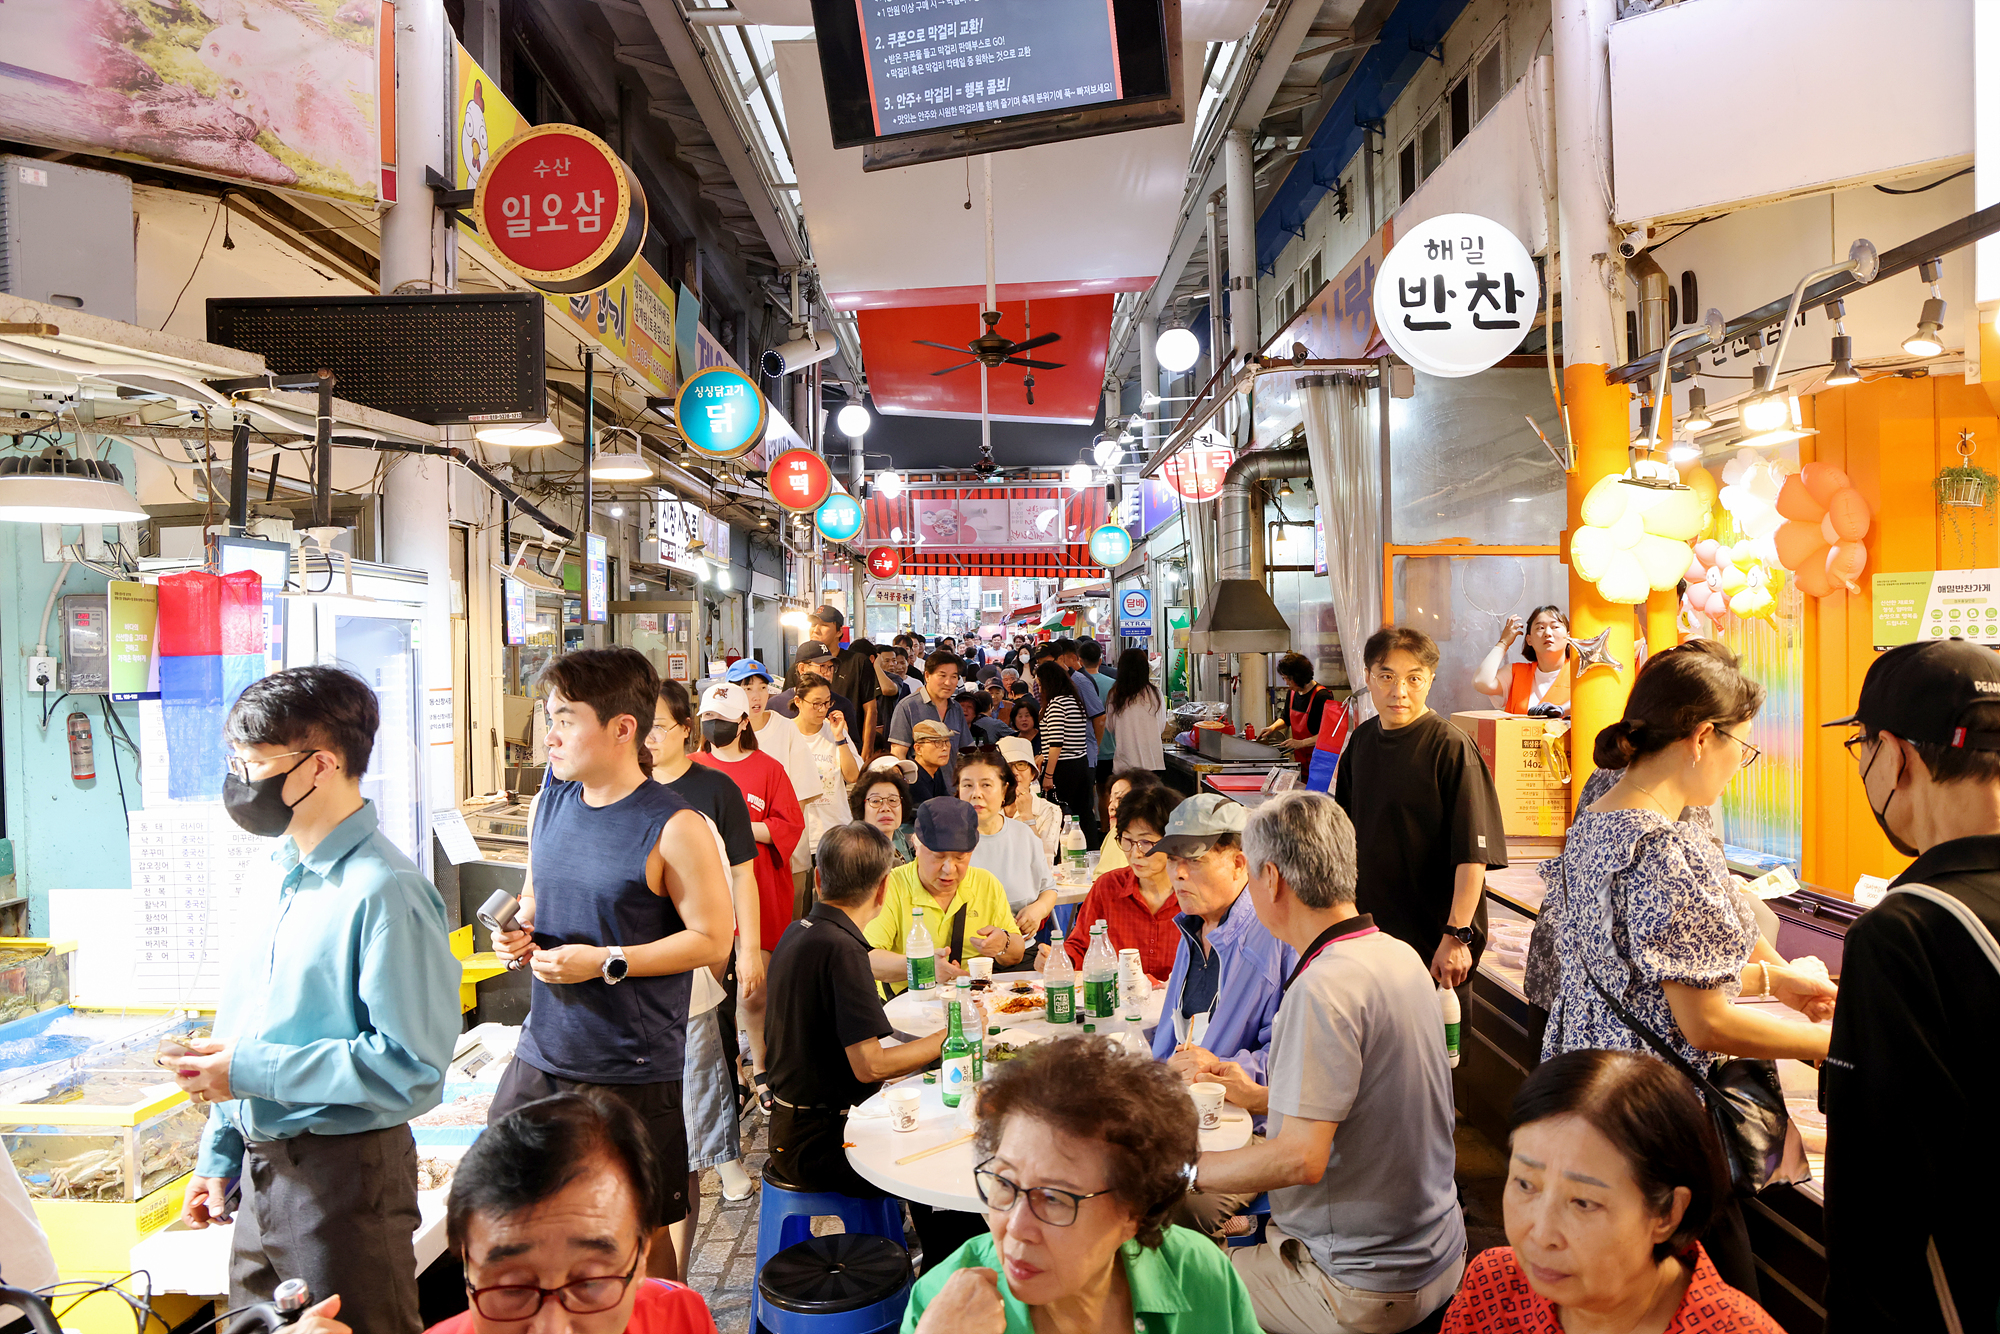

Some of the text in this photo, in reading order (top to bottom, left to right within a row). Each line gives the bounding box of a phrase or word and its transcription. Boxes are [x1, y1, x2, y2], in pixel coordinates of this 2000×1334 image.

[886, 5, 901, 17] 만원
[901, 3, 915, 14] 이상
[916, 0, 930, 11] 구매
[875, 18, 984, 50] 2. 쿠폰으로 막걸리 교환!
[888, 36, 1006, 65] 받은 쿠폰을 들고 막걸리 판매부스로 GO!
[890, 66, 910, 80] 막걸리
[912, 64, 925, 75] 혹은
[926, 60, 946, 74] 막걸리
[967, 56, 974, 67] 중
[975, 52, 995, 66] 원하는
[996, 49, 1017, 62] 것으로
[1018, 46, 1032, 58] 교환
[884, 97, 894, 110] 3.
[896, 92, 922, 109] 안주+
[924, 85, 953, 104] 막걸리
[964, 80, 985, 98] 행복
[986, 76, 1011, 95] 콤보!
[897, 114, 917, 126] 맛있는
[918, 110, 937, 122] 안주와
[939, 106, 958, 118] 시원한
[958, 102, 985, 115] 막걸리를
[986, 99, 1000, 111] 함께
[1000, 96, 1021, 109] 즐기며
[1022, 94, 1036, 104] 축제
[1036, 89, 1063, 104] 분위기에
[1076, 82, 1113, 97] 빠져보세요!
[533, 157, 572, 179] 수산
[502, 189, 605, 239] 일오삼
[1424, 236, 1486, 265] 해밀
[1398, 272, 1525, 332] 반찬
[694, 384, 744, 398] 싱싱닭고기
[705, 402, 736, 434] 닭
[788, 474, 809, 496] 떡
[1184, 478, 1218, 494] 곱창
[822, 508, 856, 526] 족발
[1098, 542, 1124, 555] 마트
[873, 559, 893, 571] 두부
[1938, 584, 1991, 594] 해밀반찬가게
[1126, 598, 1145, 608] 담배
[1174, 650, 1184, 671] LOTTE
[1523, 760, 1543, 769] 14oz
[182, 836, 204, 844] 중국산
[182, 849, 205, 857] 중국산
[146, 940, 168, 948] 바지락
